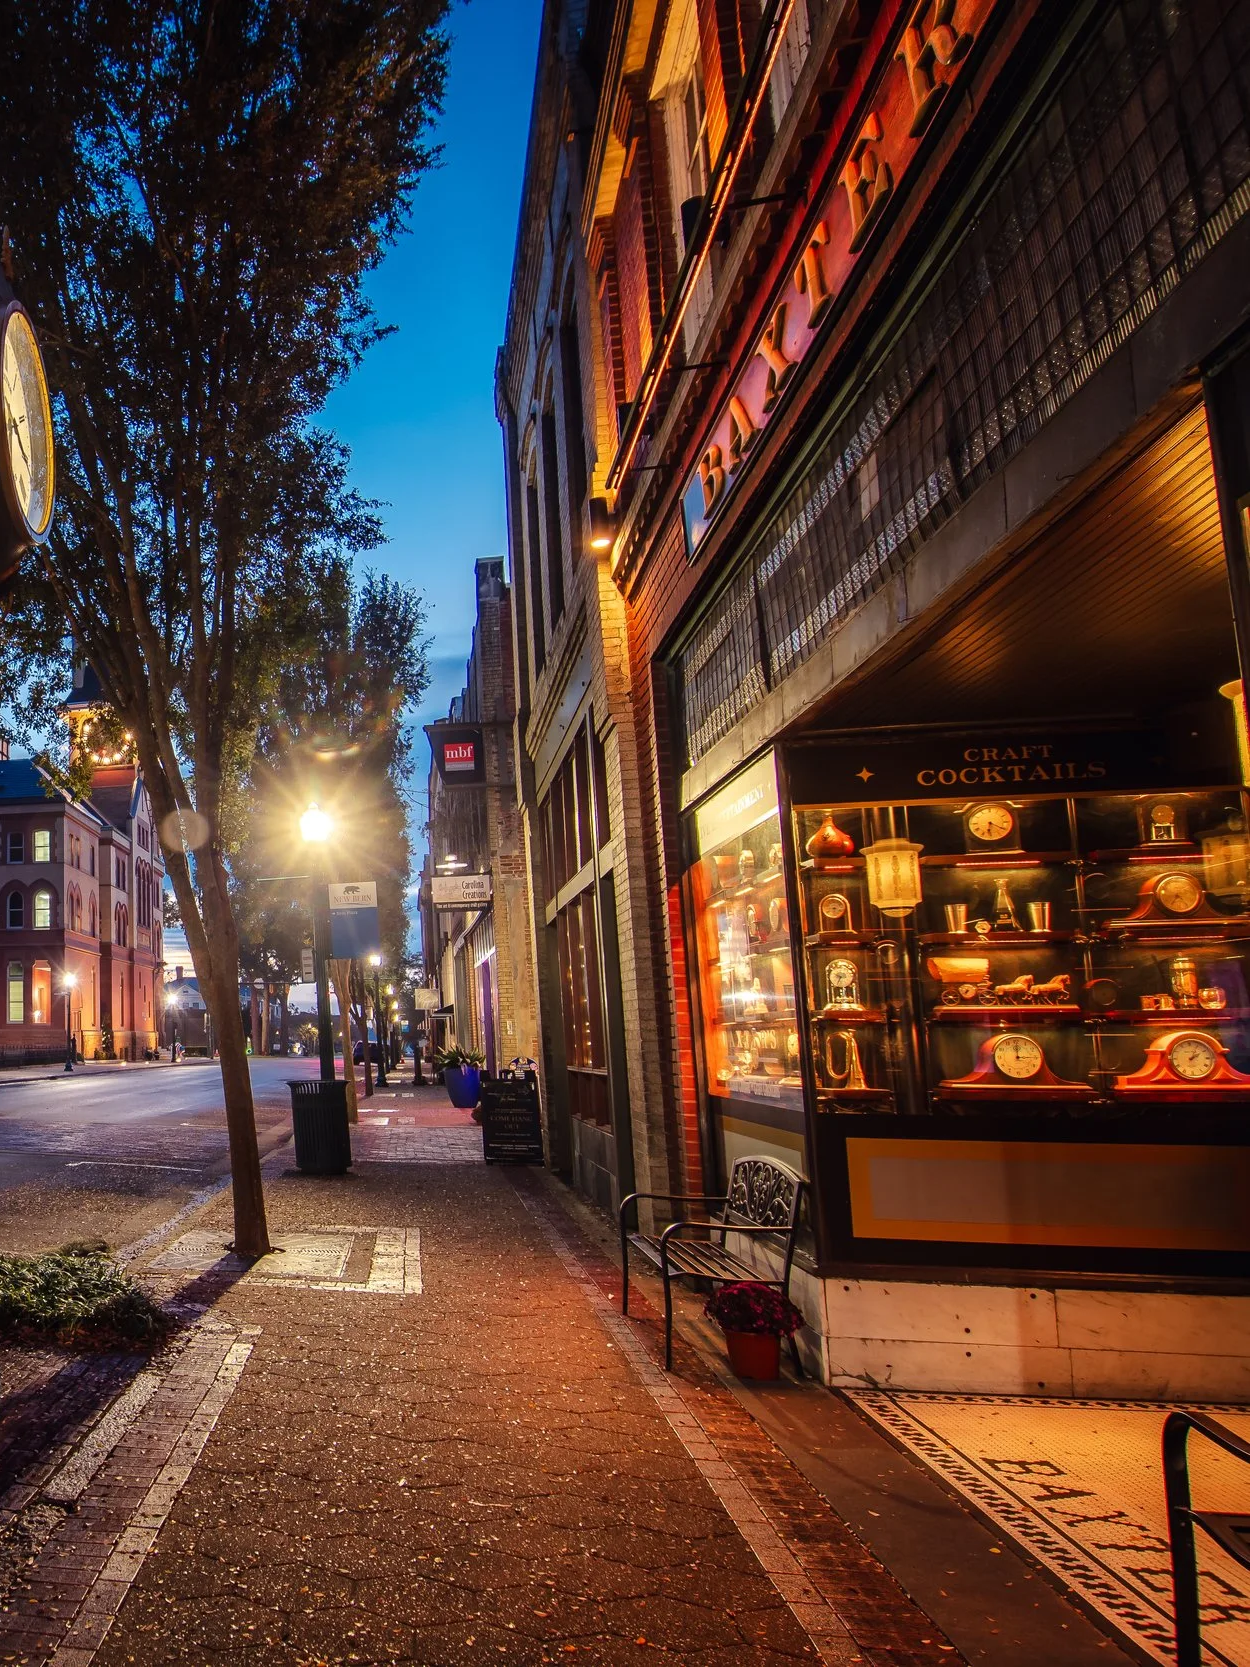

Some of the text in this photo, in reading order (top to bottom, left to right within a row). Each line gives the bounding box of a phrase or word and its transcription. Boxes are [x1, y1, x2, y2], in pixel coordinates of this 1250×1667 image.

[445, 745, 473, 759] mbf
[963, 744, 1054, 762] CRAFT
[916, 761, 1108, 786] COCKTAILS
[461, 880, 484, 890] Carolina
[333, 894, 372, 903] NEW BERN
[462, 889, 488, 899] Creations
